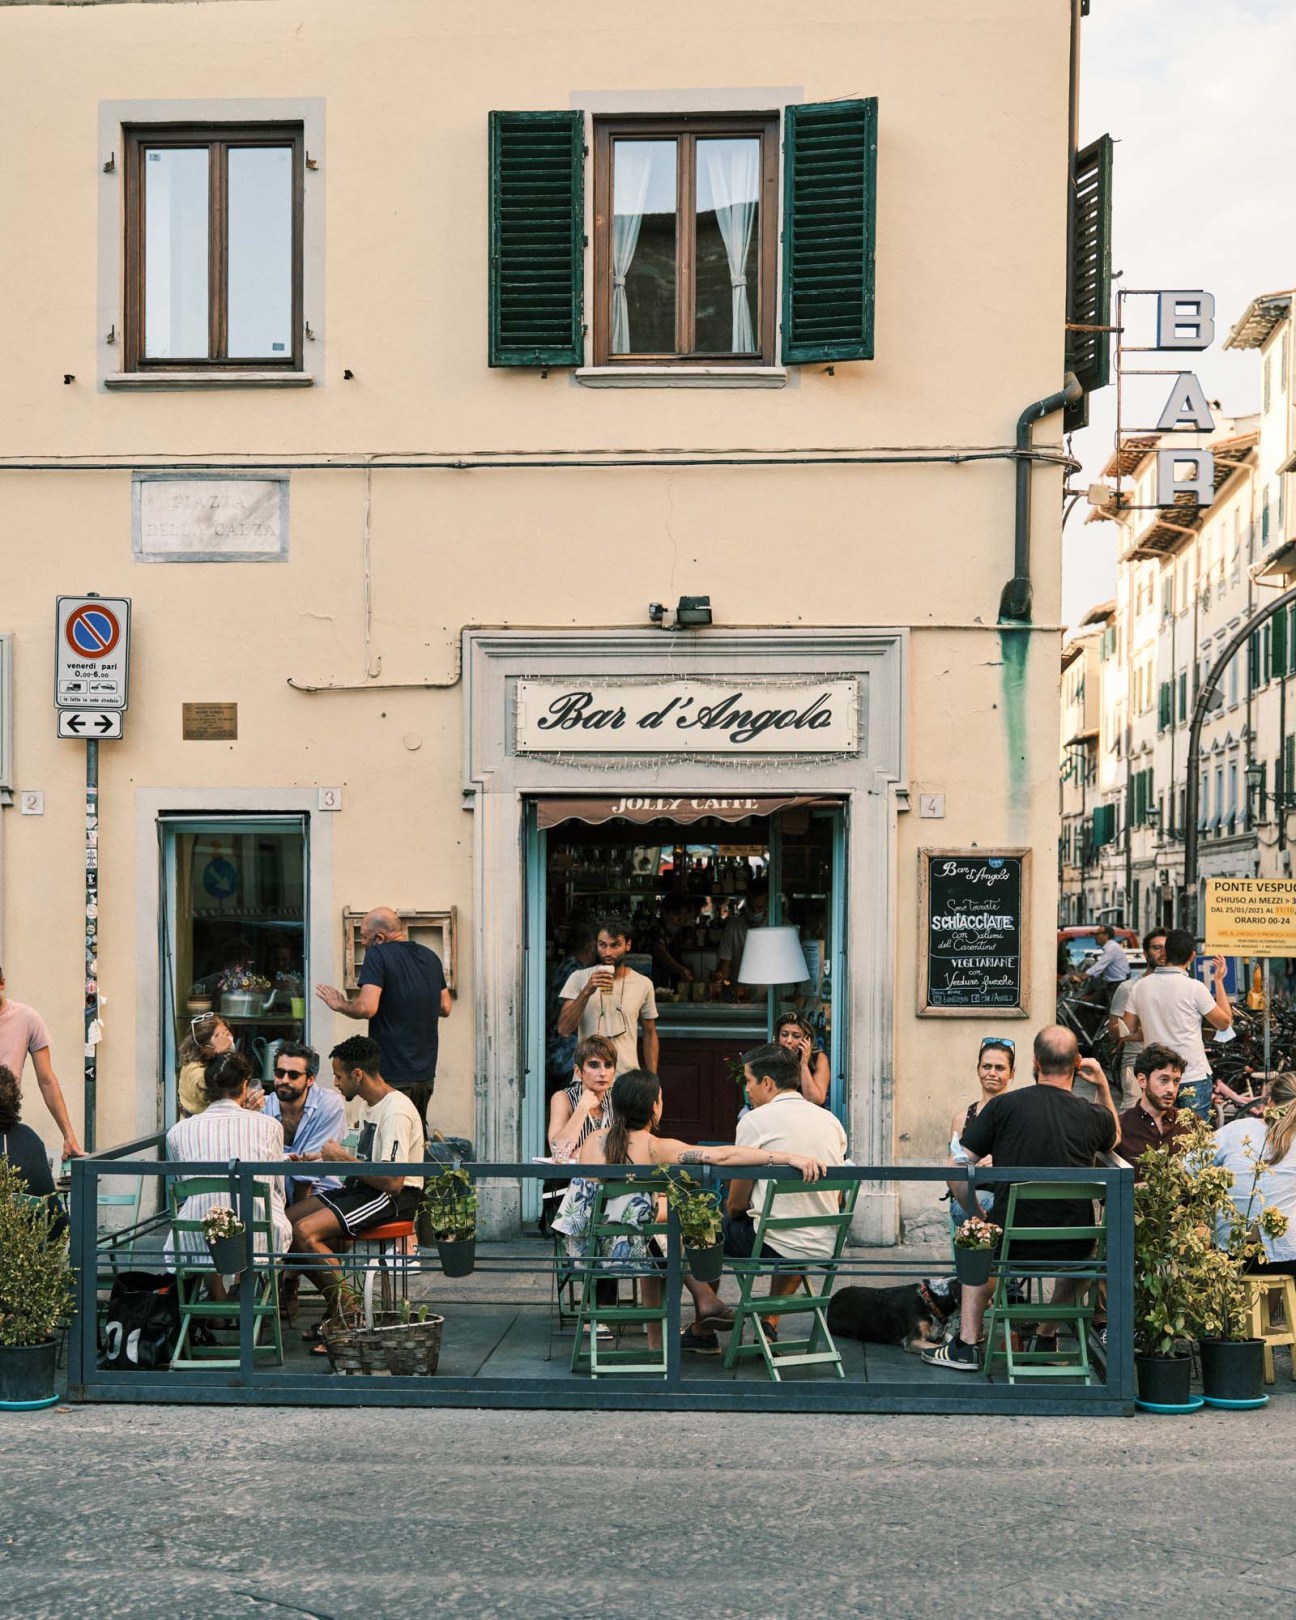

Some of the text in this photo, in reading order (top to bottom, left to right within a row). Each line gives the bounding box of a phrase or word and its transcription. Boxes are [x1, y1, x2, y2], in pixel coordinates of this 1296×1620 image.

[1157, 291, 1215, 508] BAR
[214, 522, 277, 537] CALZA
[538, 691, 833, 744] Bar d'Angolo
[27, 795, 37, 811] 2
[325, 790, 335, 807] 3
[612, 798, 681, 814] JOLLY
[927, 798, 937, 816] 4
[934, 861, 969, 878] Bar
[966, 867, 1009, 886] d'Angolo
[1214, 882, 1253, 892] PONTE
[1215, 896, 1247, 904] CHIUSO
[1258, 897, 1283, 905] MEZZI
[1225, 906, 1264, 914] 25/01/2021
[931, 912, 1015, 931] SCHIACCIATE
[1234, 916, 1291, 925] ORARIO 00-24
[951, 931, 968, 940] con
[937, 938, 997, 952] del Casentino
[951, 957, 1015, 968] VEGETARIANE
[944, 970, 980, 990] Verdure
[968, 969, 983, 977] con
